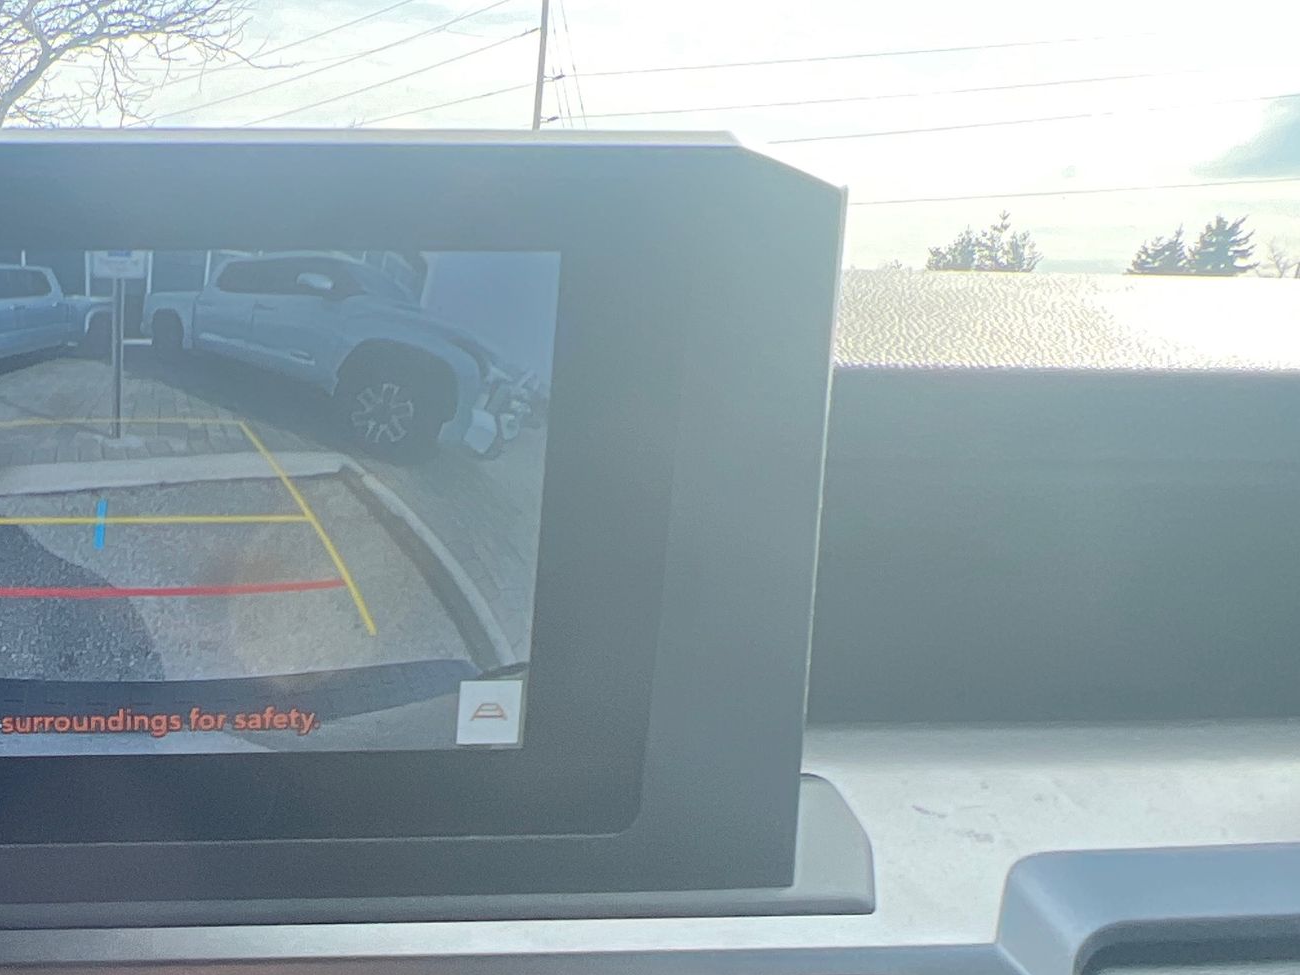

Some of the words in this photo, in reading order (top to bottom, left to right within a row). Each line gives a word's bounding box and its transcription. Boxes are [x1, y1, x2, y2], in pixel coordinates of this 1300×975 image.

[2, 708, 182, 738] surroundings
[189, 708, 226, 732] for
[234, 705, 321, 736] safety.
